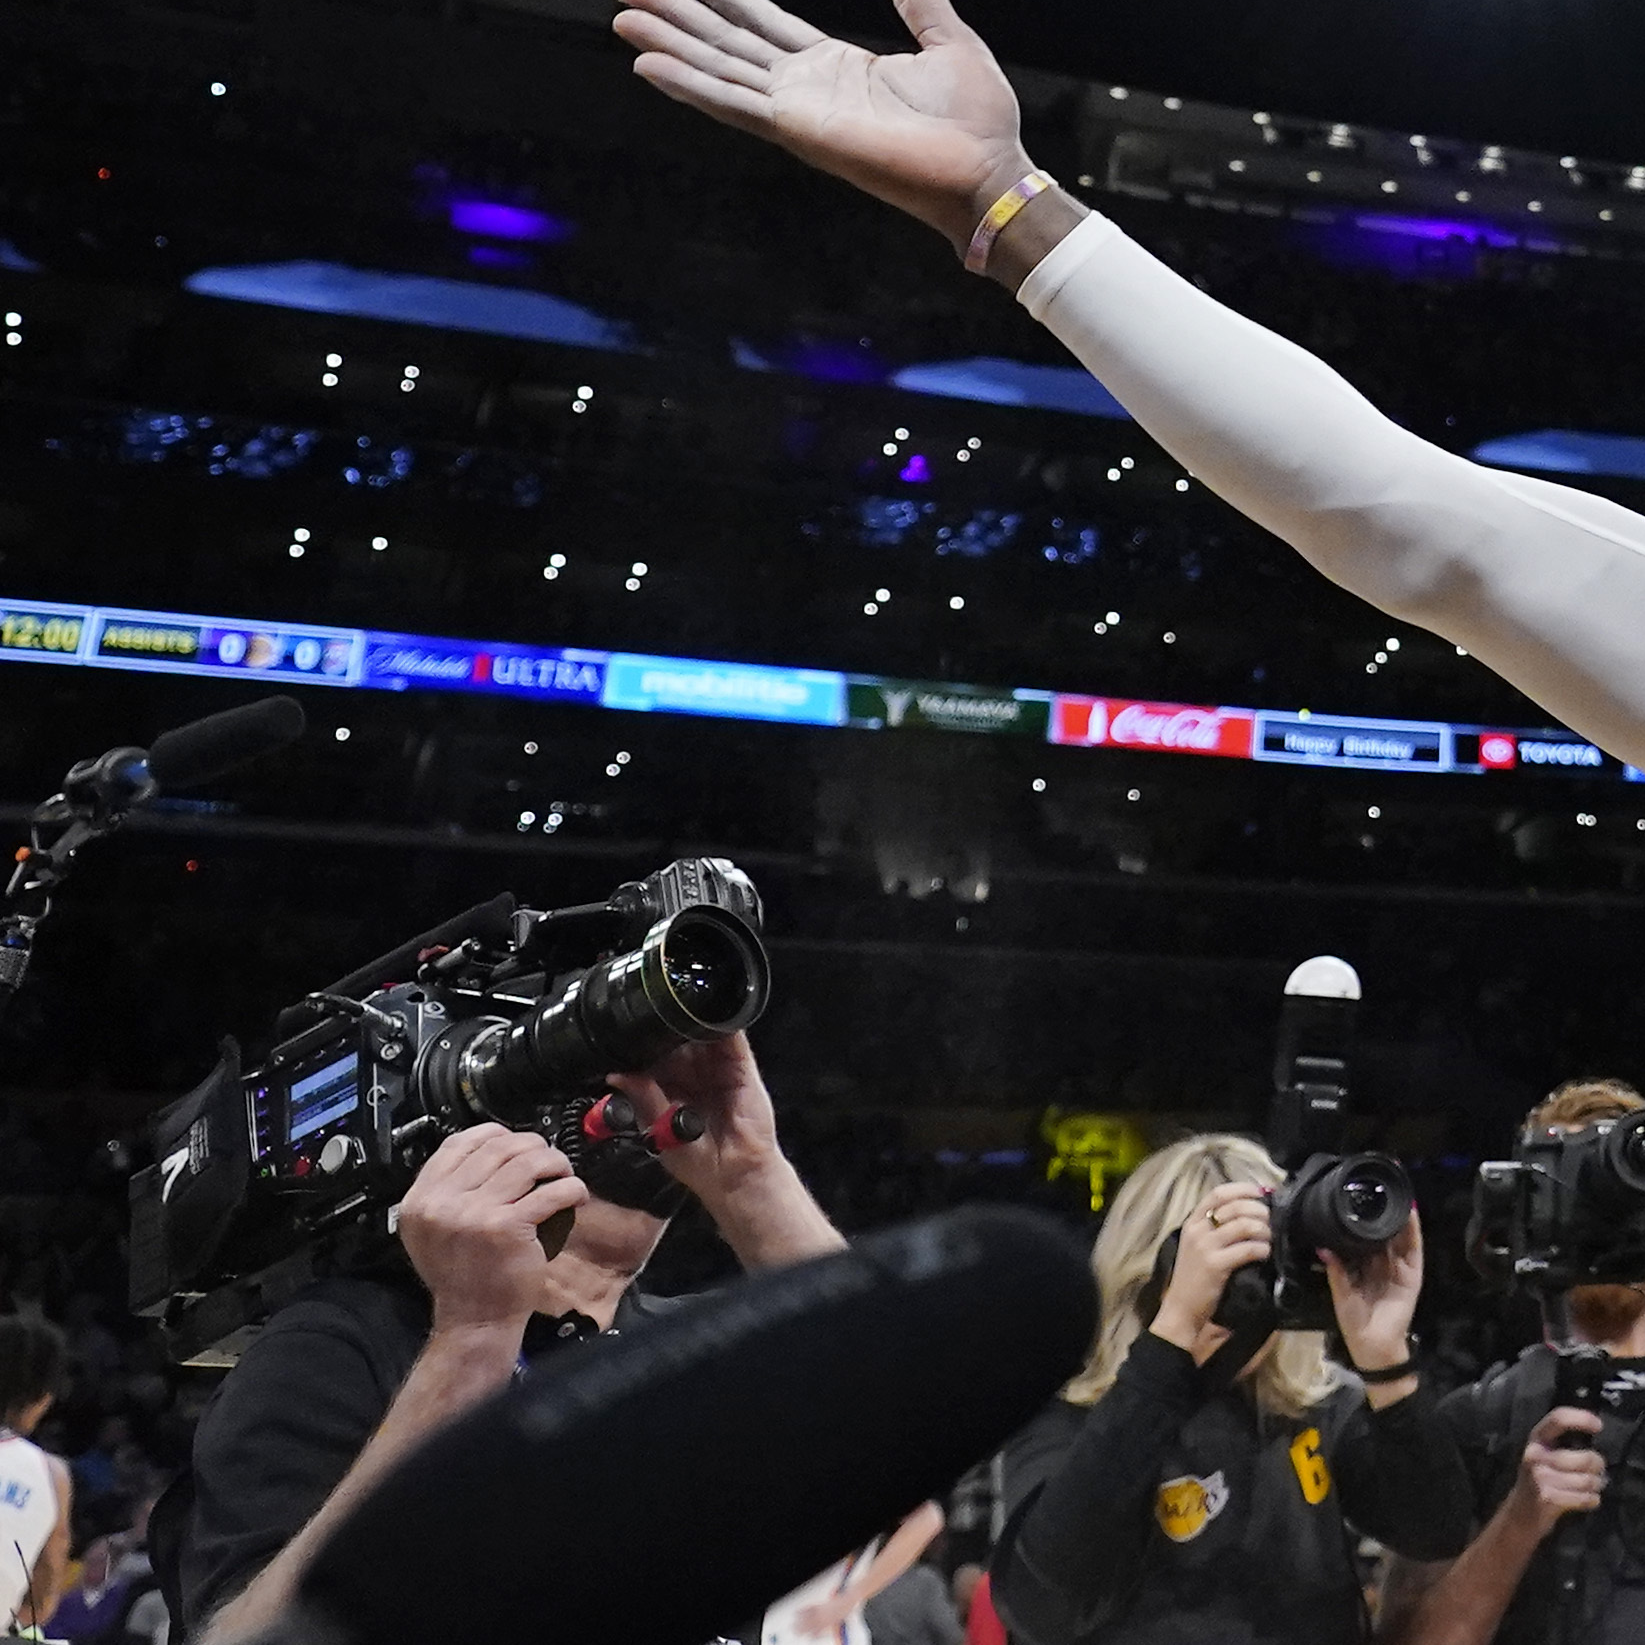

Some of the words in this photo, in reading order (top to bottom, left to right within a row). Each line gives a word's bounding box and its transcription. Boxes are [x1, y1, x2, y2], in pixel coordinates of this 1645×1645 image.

[492, 658, 601, 692] ULTRA
[1518, 742, 1601, 767] TOYOTA
[1290, 1428, 1331, 1505] 6
